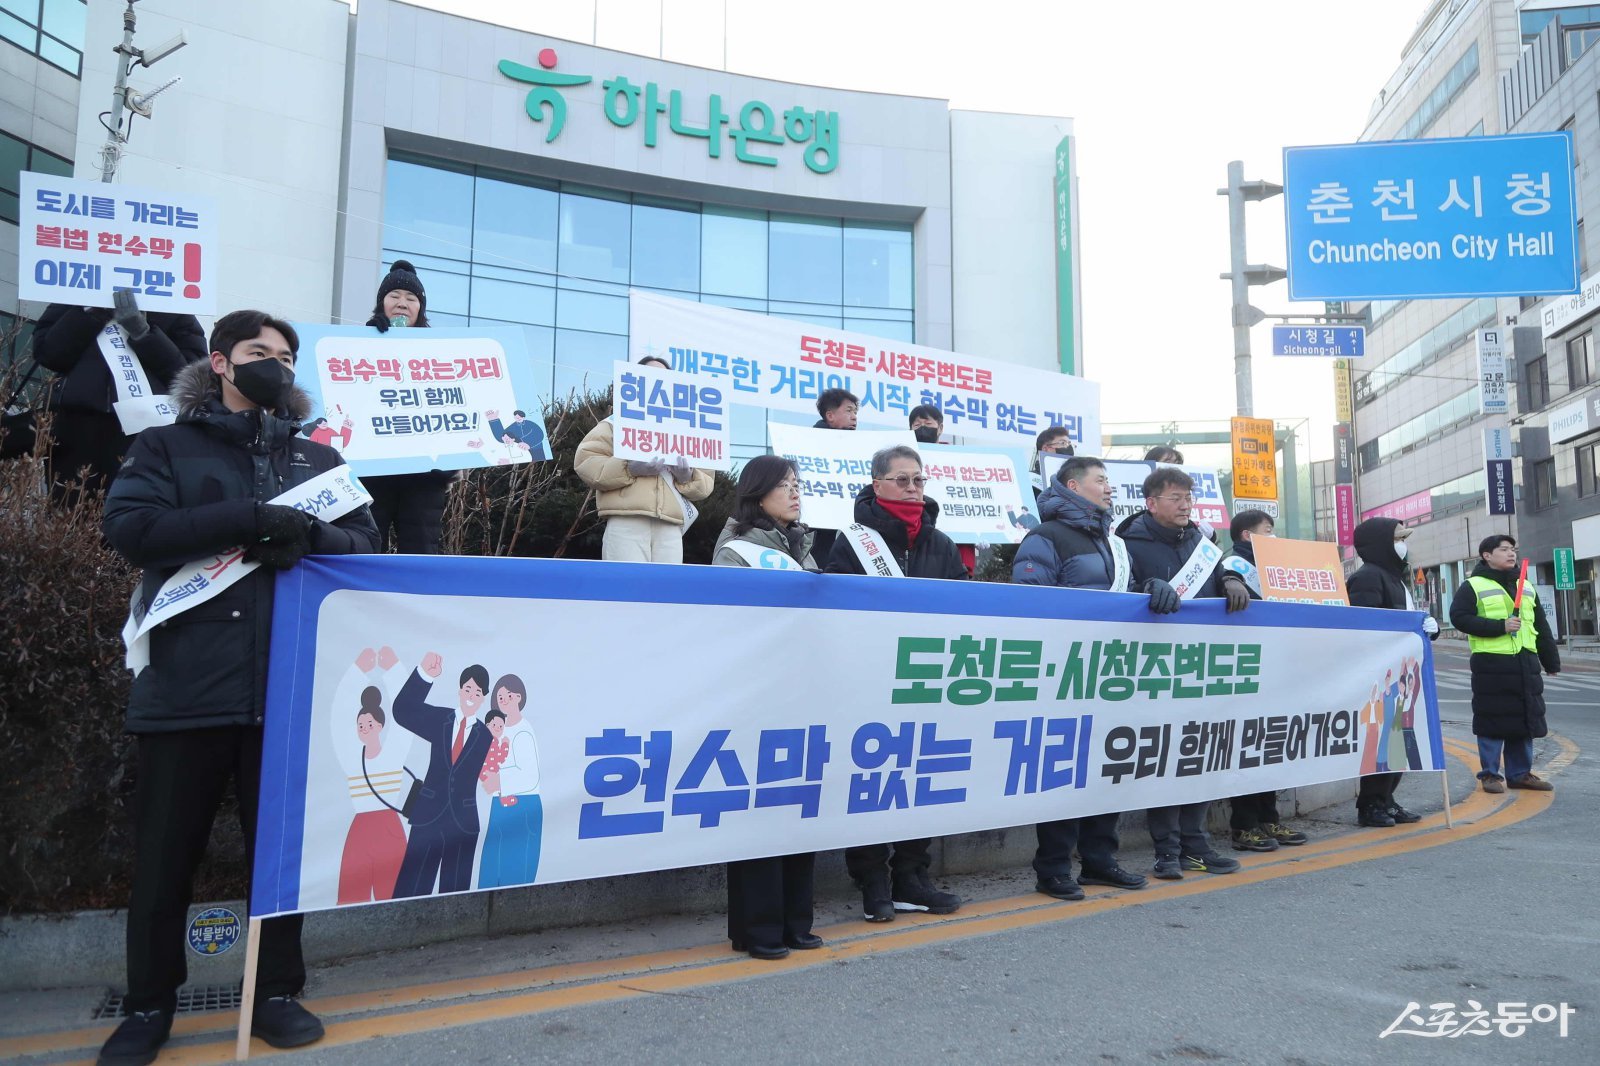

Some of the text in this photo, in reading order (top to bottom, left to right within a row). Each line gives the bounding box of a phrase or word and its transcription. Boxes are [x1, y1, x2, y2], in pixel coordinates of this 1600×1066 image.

[602, 76, 839, 174] 하나은행
[36, 189, 199, 229] 도시를 가리는
[36, 224, 175, 260] 불법 현수막
[1308, 231, 1554, 264] Chuncheon City Hall
[34, 259, 176, 297] 이제 그만
[1283, 344, 1341, 356] Sicheong-gil
[1289, 329, 1336, 344] 시청길
[118, 355, 143, 398] 캠페인
[326, 357, 402, 382] 현수막
[800, 335, 993, 394] 도청로·시청주변도로
[379, 387, 464, 407] 우리 함께
[620, 372, 722, 431] 현수막은
[861, 379, 911, 416] 시작
[995, 402, 1037, 436] 없는
[371, 412, 478, 435] 만들어가요!
[1552, 410, 1583, 432] PHILIPS
[620, 427, 722, 460] 지정게시대에!
[1235, 457, 1274, 472] 무인카메라
[1238, 475, 1272, 487] 단속중
[946, 486, 993, 499] 우리 함께
[1495, 463, 1506, 512] 필립스보청기
[942, 503, 1001, 517] 만들어가요!
[1308, 570, 1336, 591] 맑음!
[891, 635, 1262, 706] 도청로·시청주변도로
[578, 710, 1359, 839] 현수막 없는 거리 우리 함께 만들어가요!
[191, 925, 236, 943] 빗물받이
